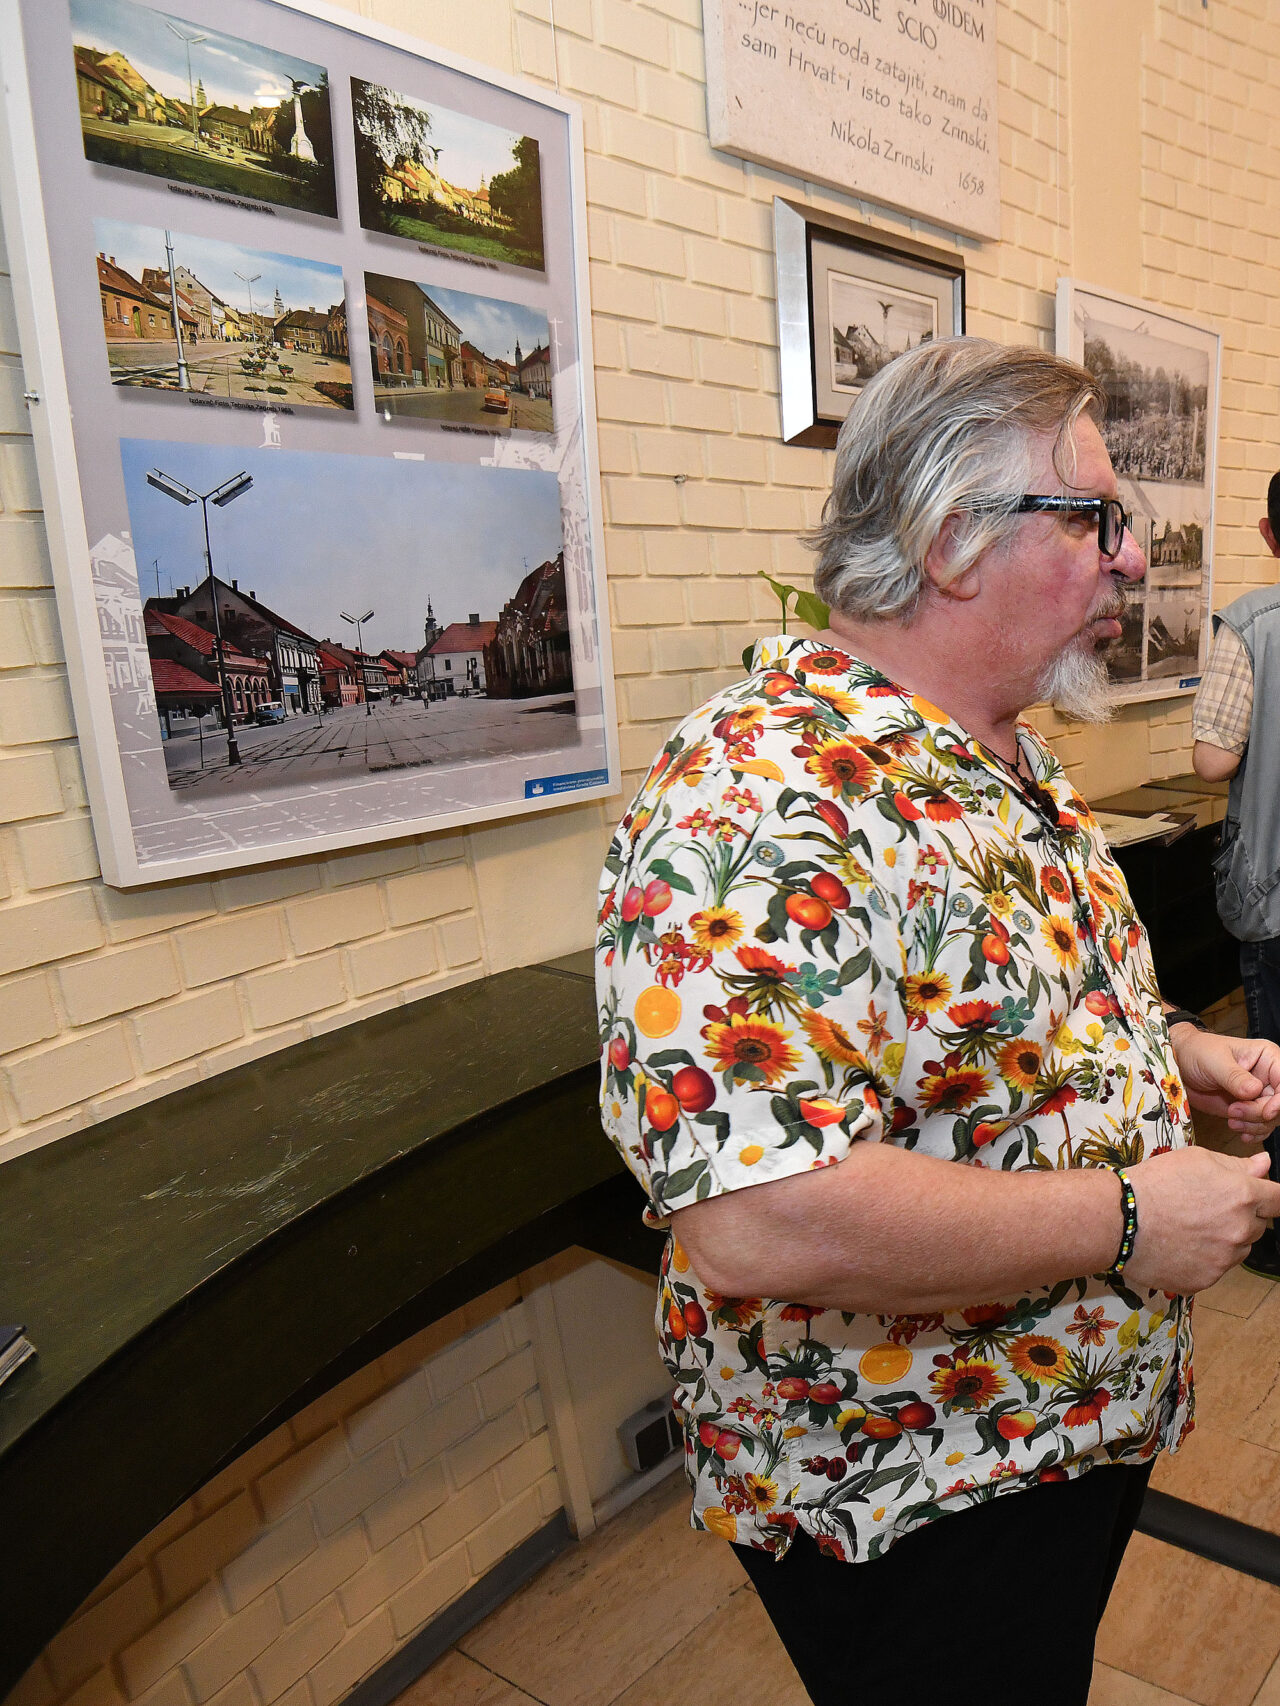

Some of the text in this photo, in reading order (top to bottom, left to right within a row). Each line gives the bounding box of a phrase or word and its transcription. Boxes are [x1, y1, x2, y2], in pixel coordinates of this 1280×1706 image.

[897, 11, 938, 50] SCIO
[741, 33, 777, 60] sam
[788, 47, 836, 85] Hrvat
[861, 79, 891, 108] isto
[898, 98, 932, 127] tako
[832, 37, 869, 66] roda
[931, 85, 966, 112] znam
[971, 97, 989, 122] da
[830, 119, 934, 177] Nikola Zrinski
[958, 171, 986, 196] 1658
